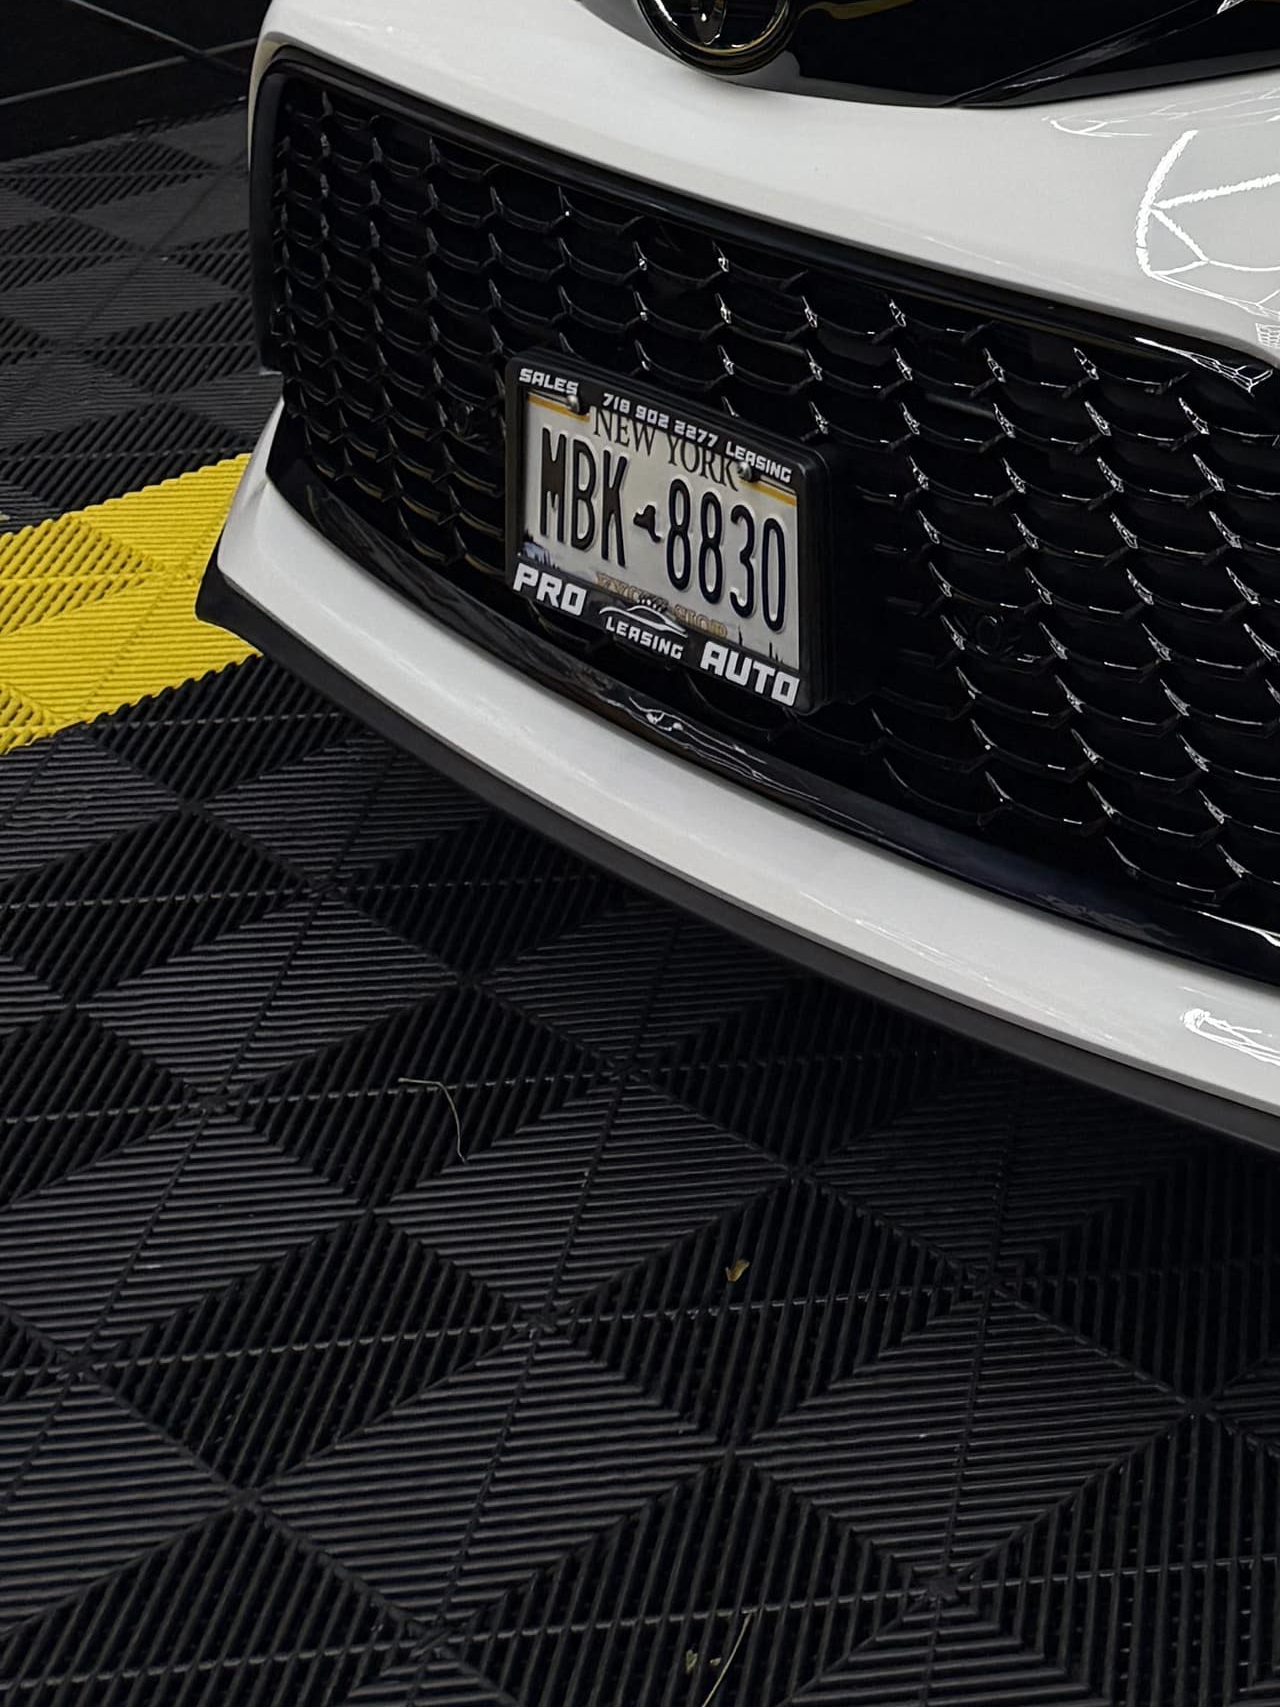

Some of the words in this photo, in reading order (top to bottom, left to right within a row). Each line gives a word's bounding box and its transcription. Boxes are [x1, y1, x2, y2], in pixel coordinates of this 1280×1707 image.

[519, 368, 578, 395] SALES
[602, 392, 631, 414] 718
[635, 405, 669, 429] 902
[674, 420, 718, 447] 2277
[725, 441, 792, 483] LEASING
[593, 409, 657, 456] NEW
[666, 433, 738, 491] YORK
[513, 563, 587, 616] PRO
[606, 616, 684, 660] LEASING
[700, 640, 800, 706] AUTO
